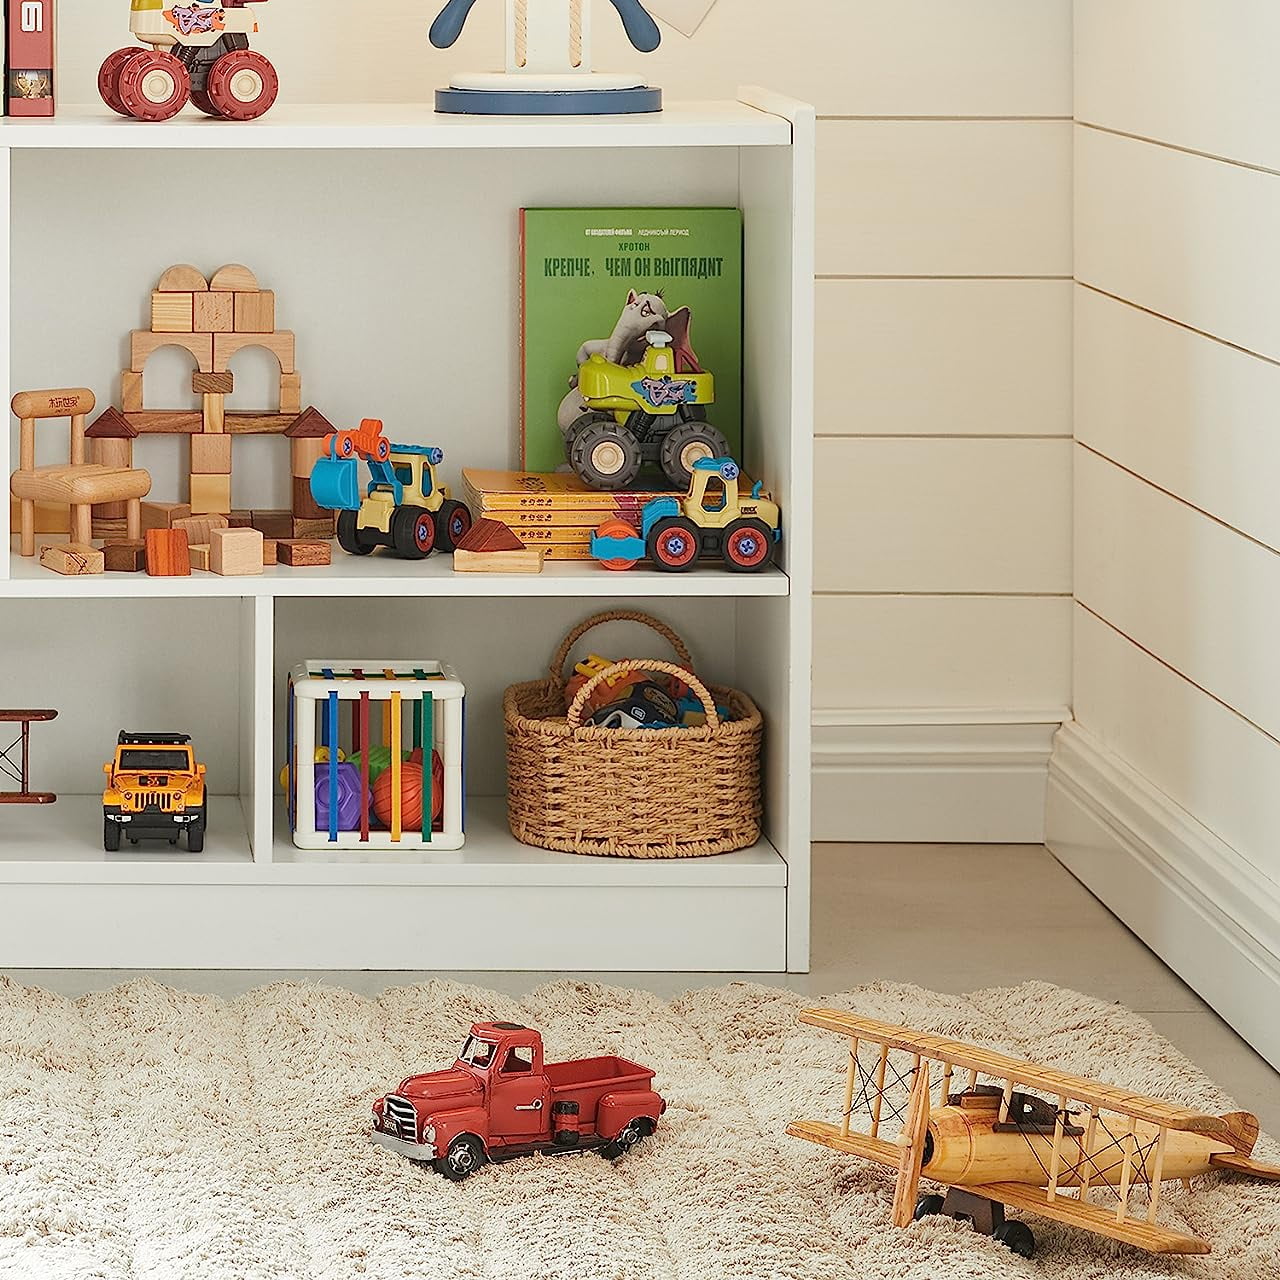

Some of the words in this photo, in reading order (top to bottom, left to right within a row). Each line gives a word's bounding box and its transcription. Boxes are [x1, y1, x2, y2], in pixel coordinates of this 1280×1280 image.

[21, 0, 43, 32] 6
[605, 258, 631, 276] ЧЕМ
[634, 258, 651, 276] ОН
